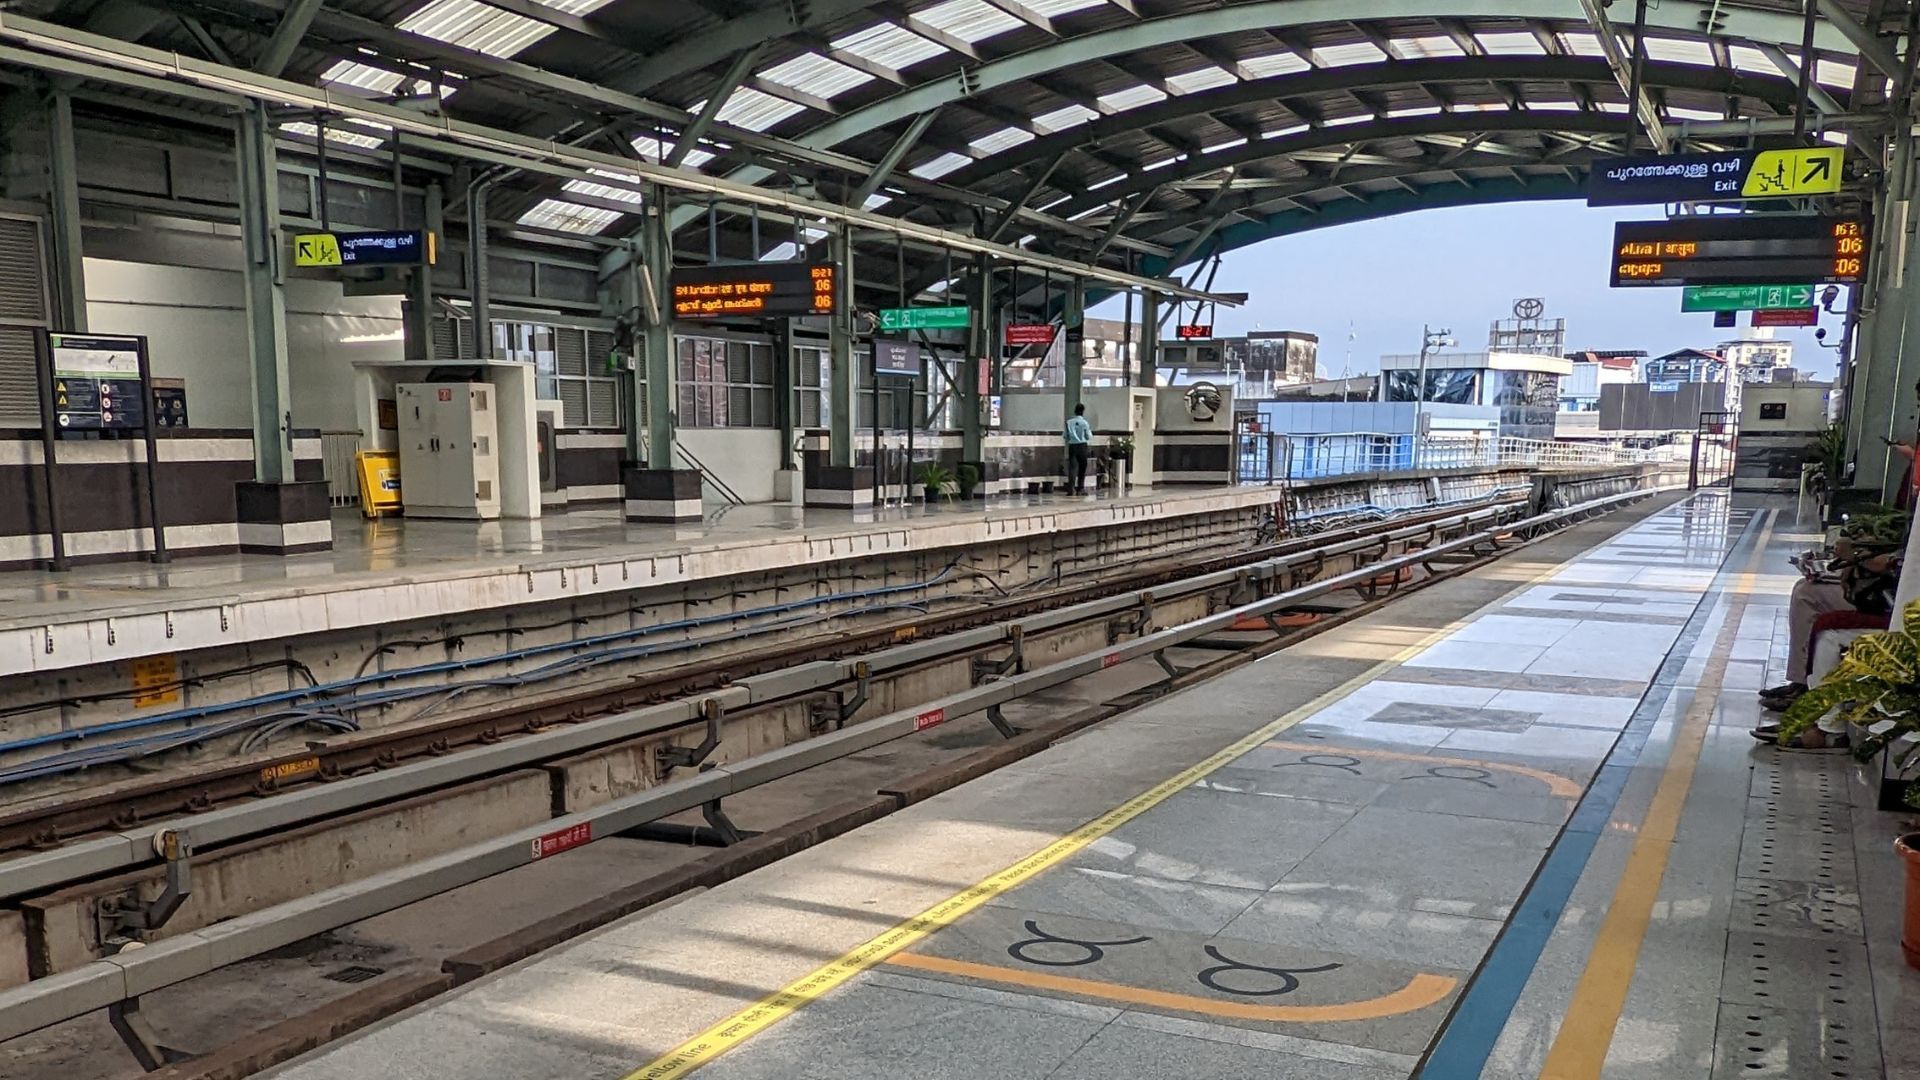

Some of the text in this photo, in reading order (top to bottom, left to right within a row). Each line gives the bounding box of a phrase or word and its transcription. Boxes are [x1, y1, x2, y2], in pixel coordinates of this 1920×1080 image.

[1711, 158, 1741, 173] വഴി
[1713, 180, 1738, 192] Exit
[343, 252, 356, 260] Exit
[1182, 327, 1210, 337] 16:21
[678, 1043, 712, 1058] line
